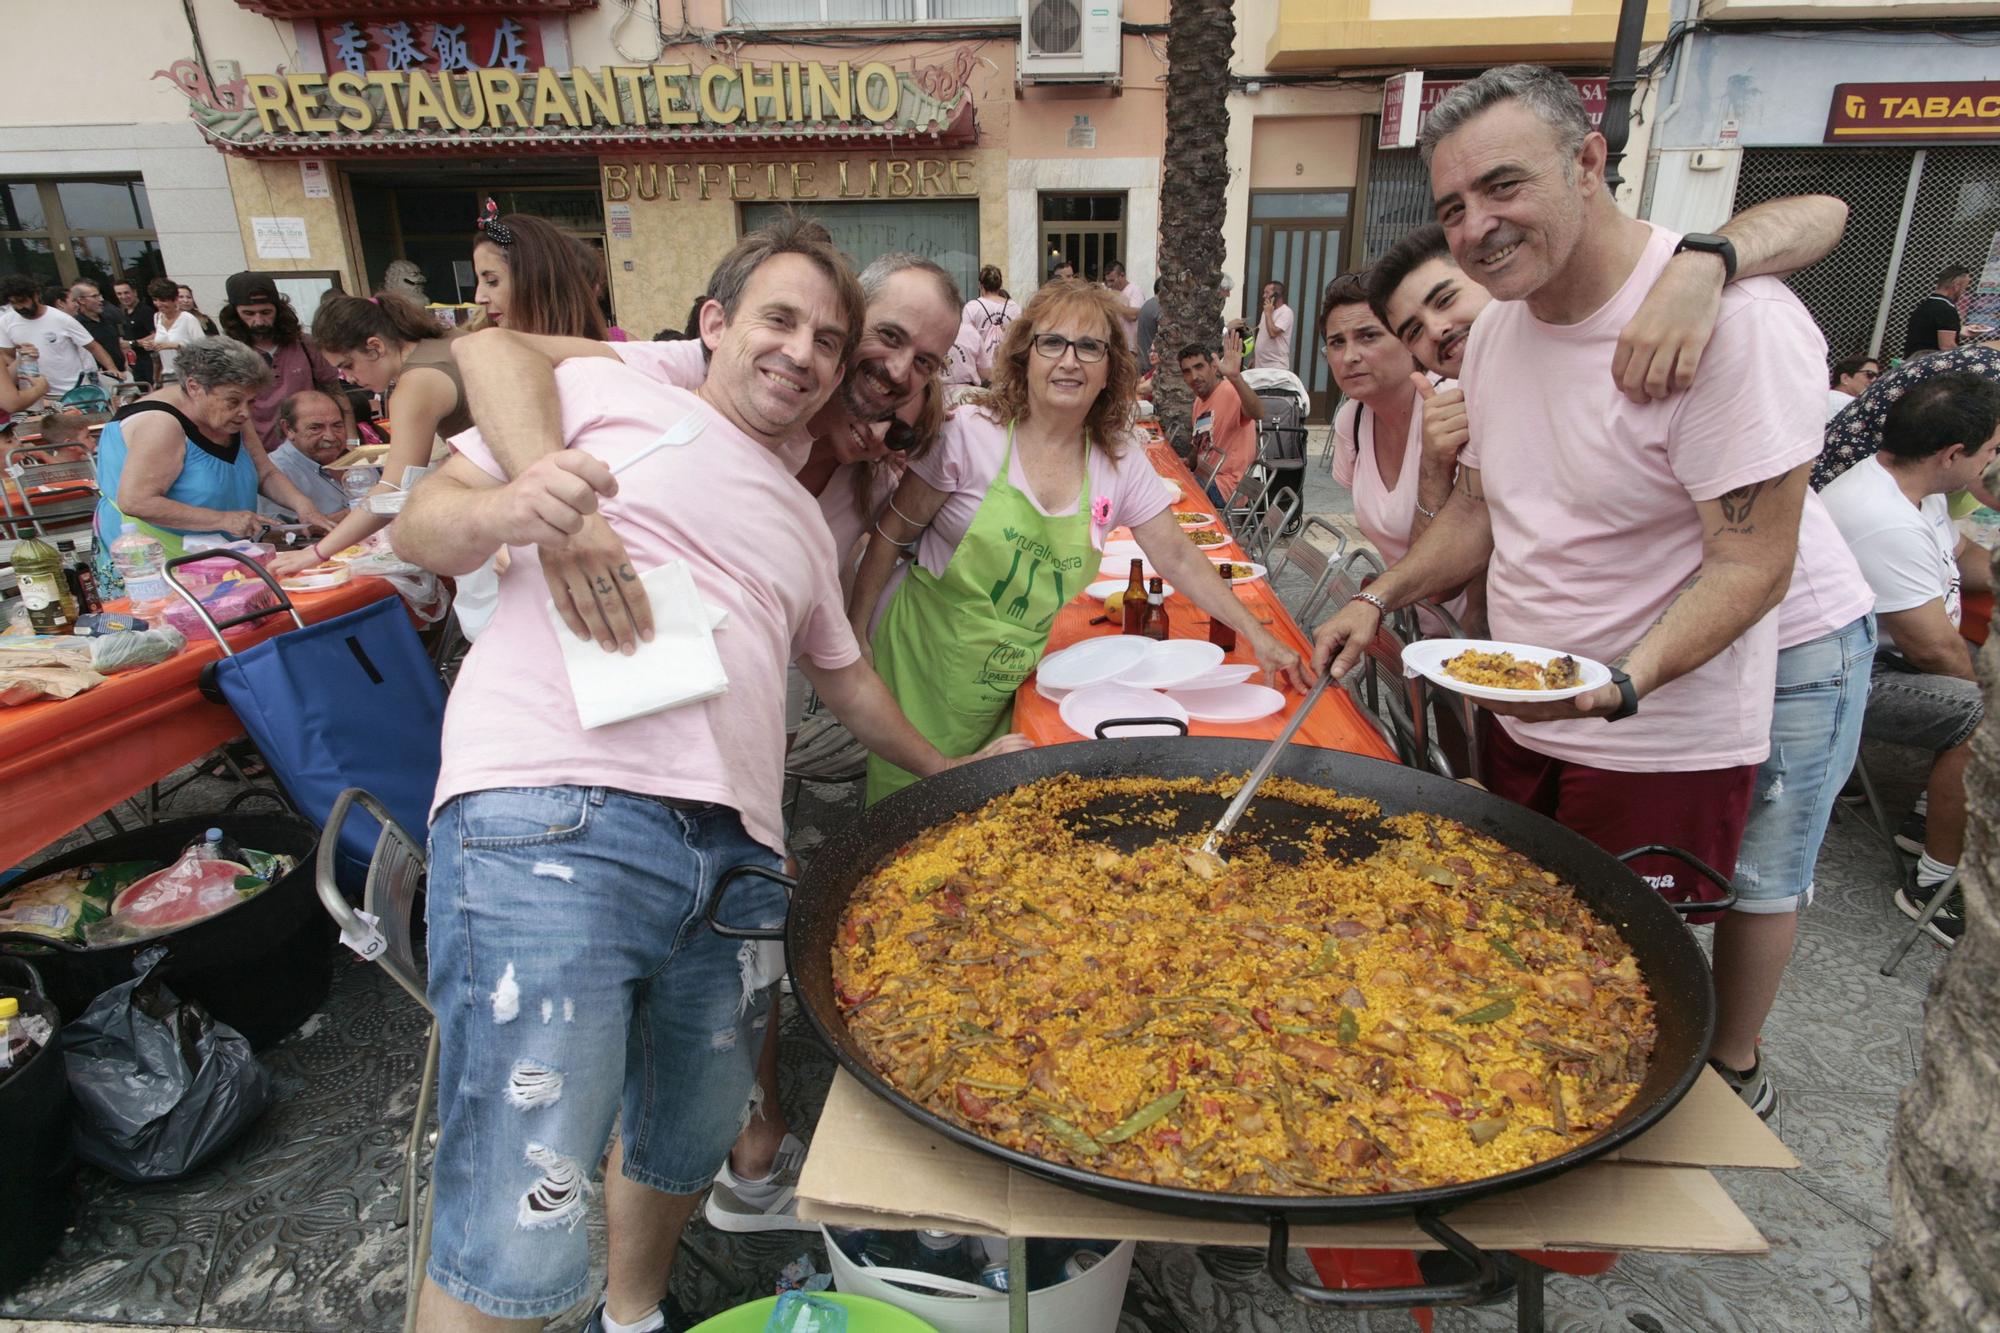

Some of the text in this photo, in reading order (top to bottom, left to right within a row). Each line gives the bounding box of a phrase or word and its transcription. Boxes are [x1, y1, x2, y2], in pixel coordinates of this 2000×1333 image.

[603, 159, 979, 201] BUFFETE LIBRE
[1295, 163, 1304, 176] 9
[1016, 535, 1082, 571] ruralnostra
